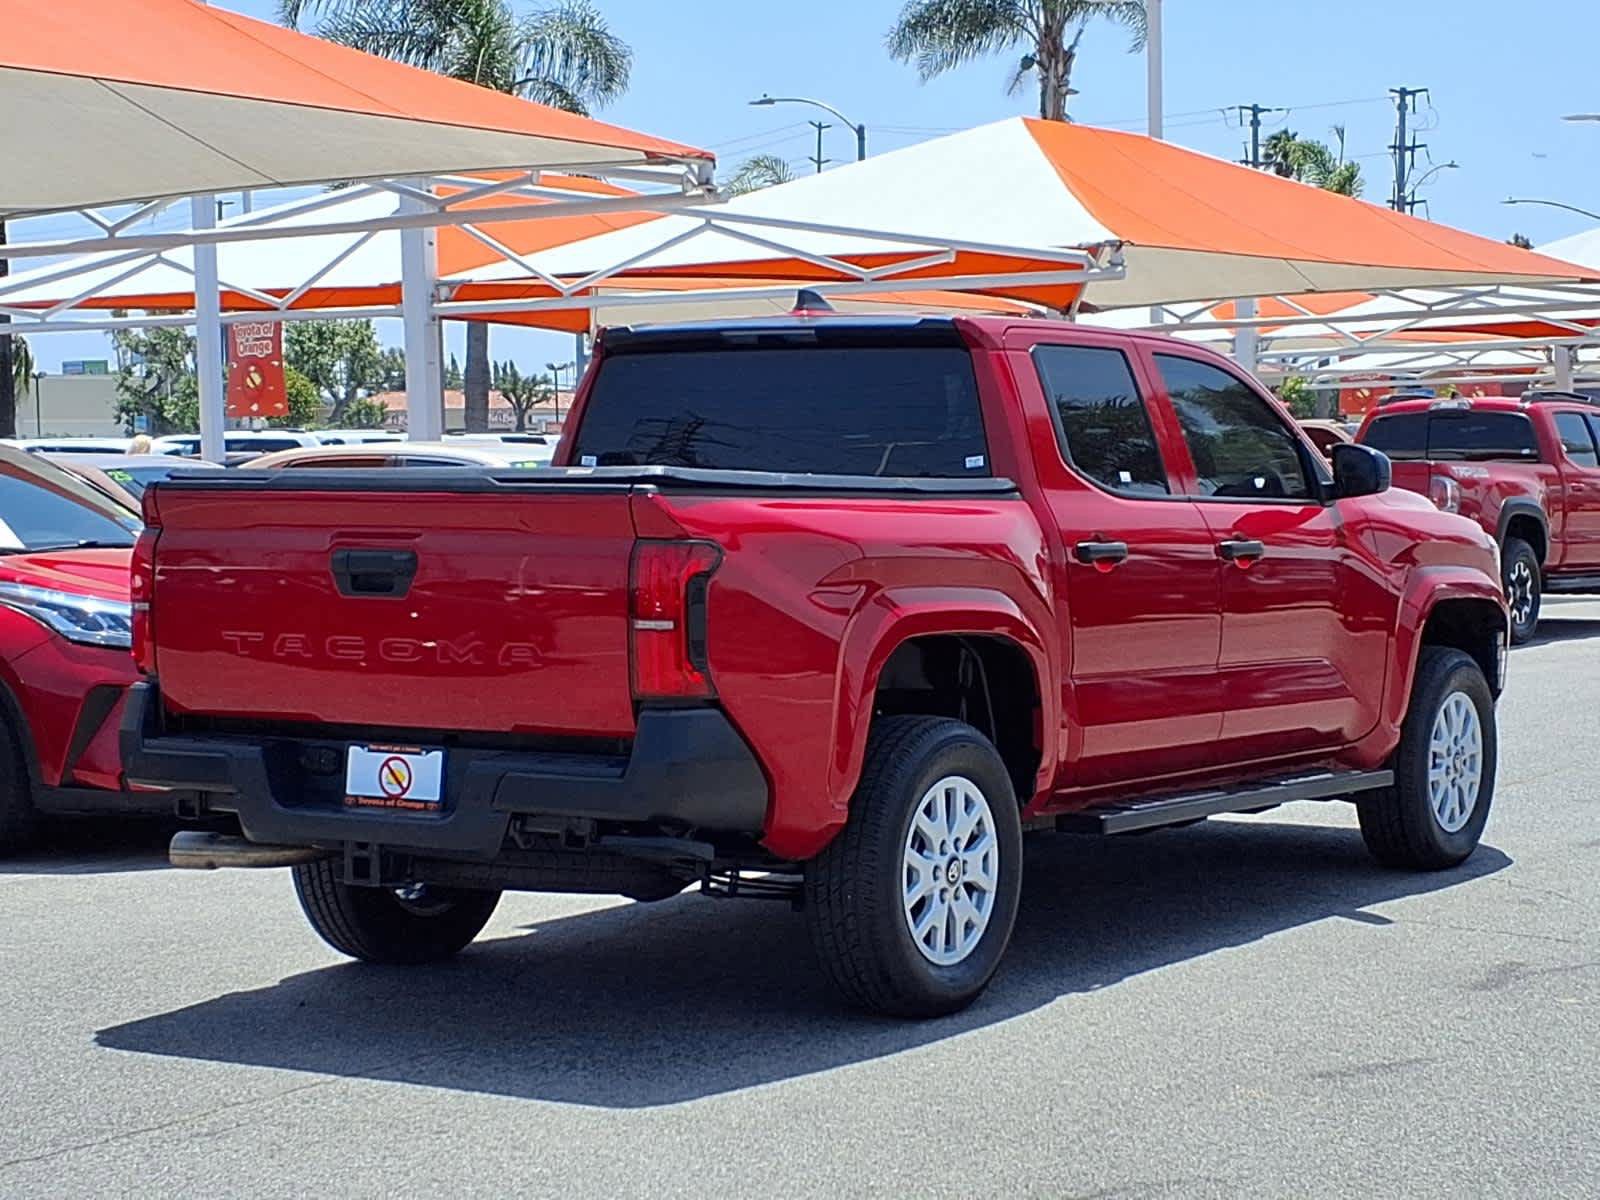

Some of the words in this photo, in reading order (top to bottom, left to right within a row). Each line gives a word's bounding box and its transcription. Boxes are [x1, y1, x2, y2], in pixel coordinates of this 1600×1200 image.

[233, 322, 261, 339] Toyota
[262, 321, 273, 336] of
[238, 341, 272, 357] Orange
[222, 630, 545, 667] TACOMA
